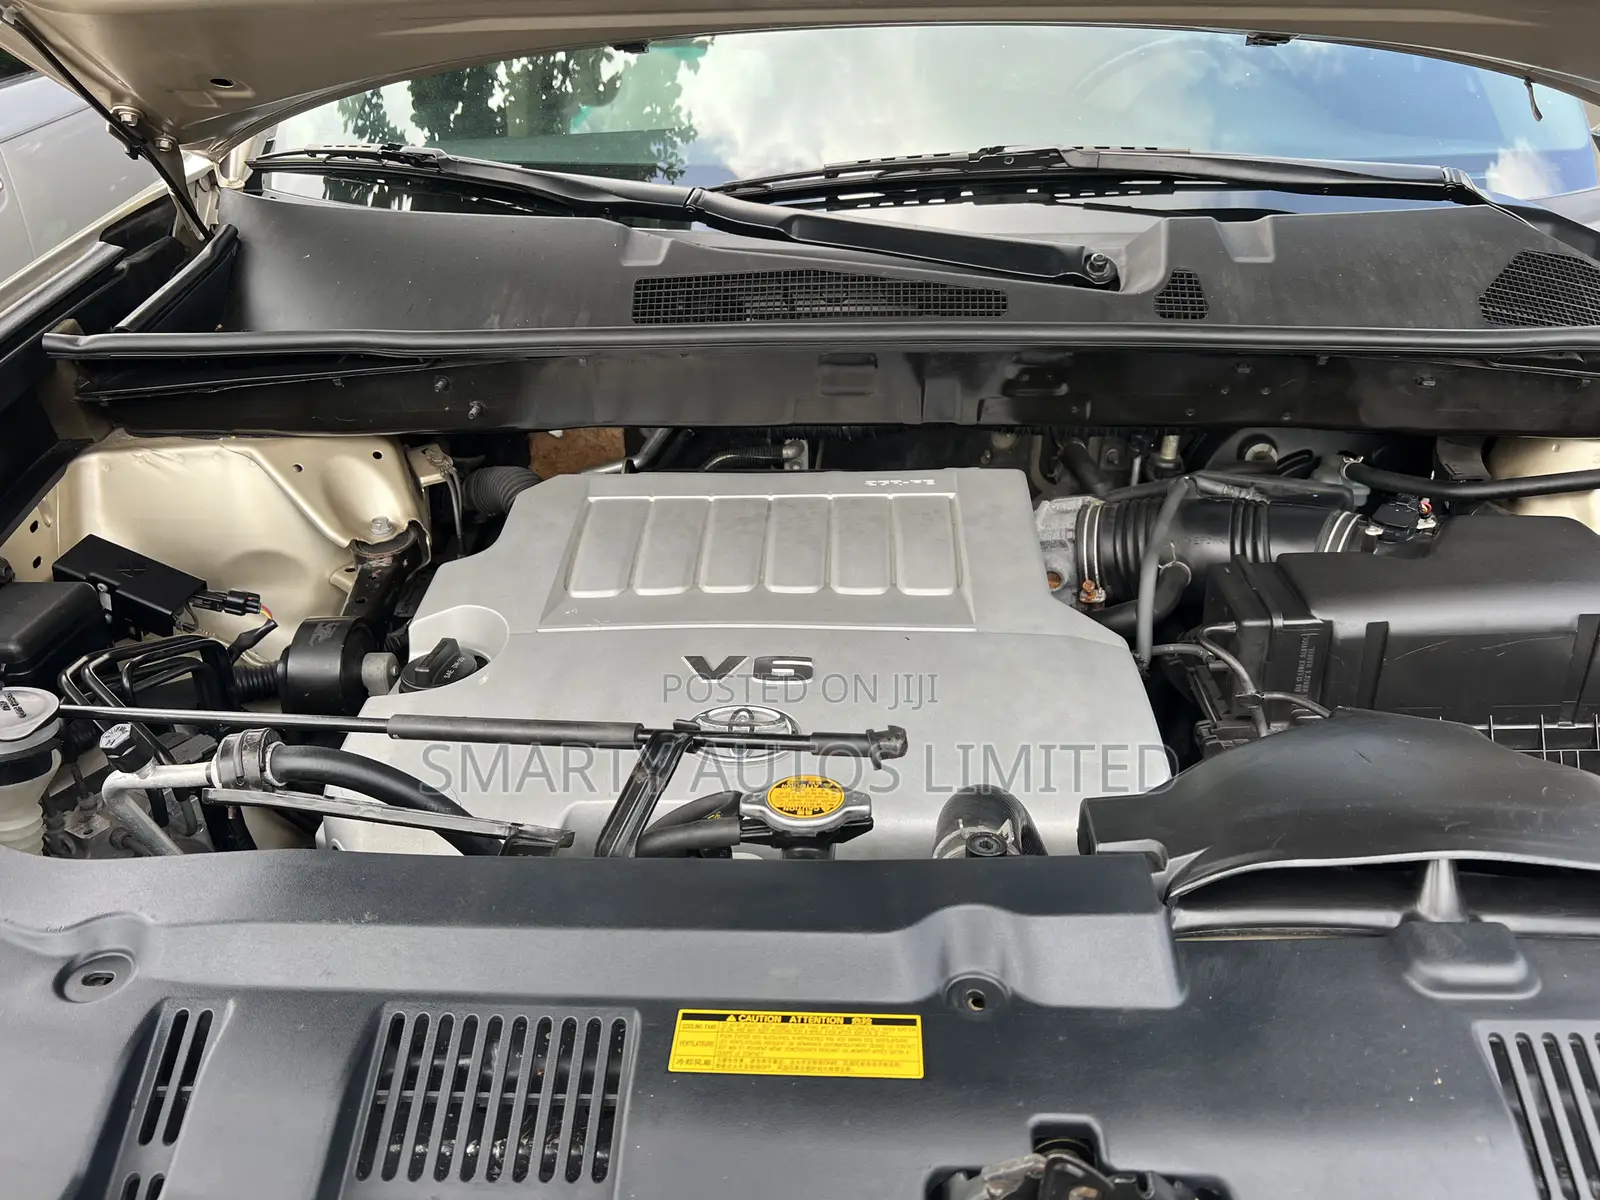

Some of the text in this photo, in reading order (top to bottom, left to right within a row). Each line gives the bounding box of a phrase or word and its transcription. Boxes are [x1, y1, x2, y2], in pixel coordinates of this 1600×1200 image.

[681, 655, 814, 685] V6
[738, 1015, 844, 1024] CAUTION ATTENTION
